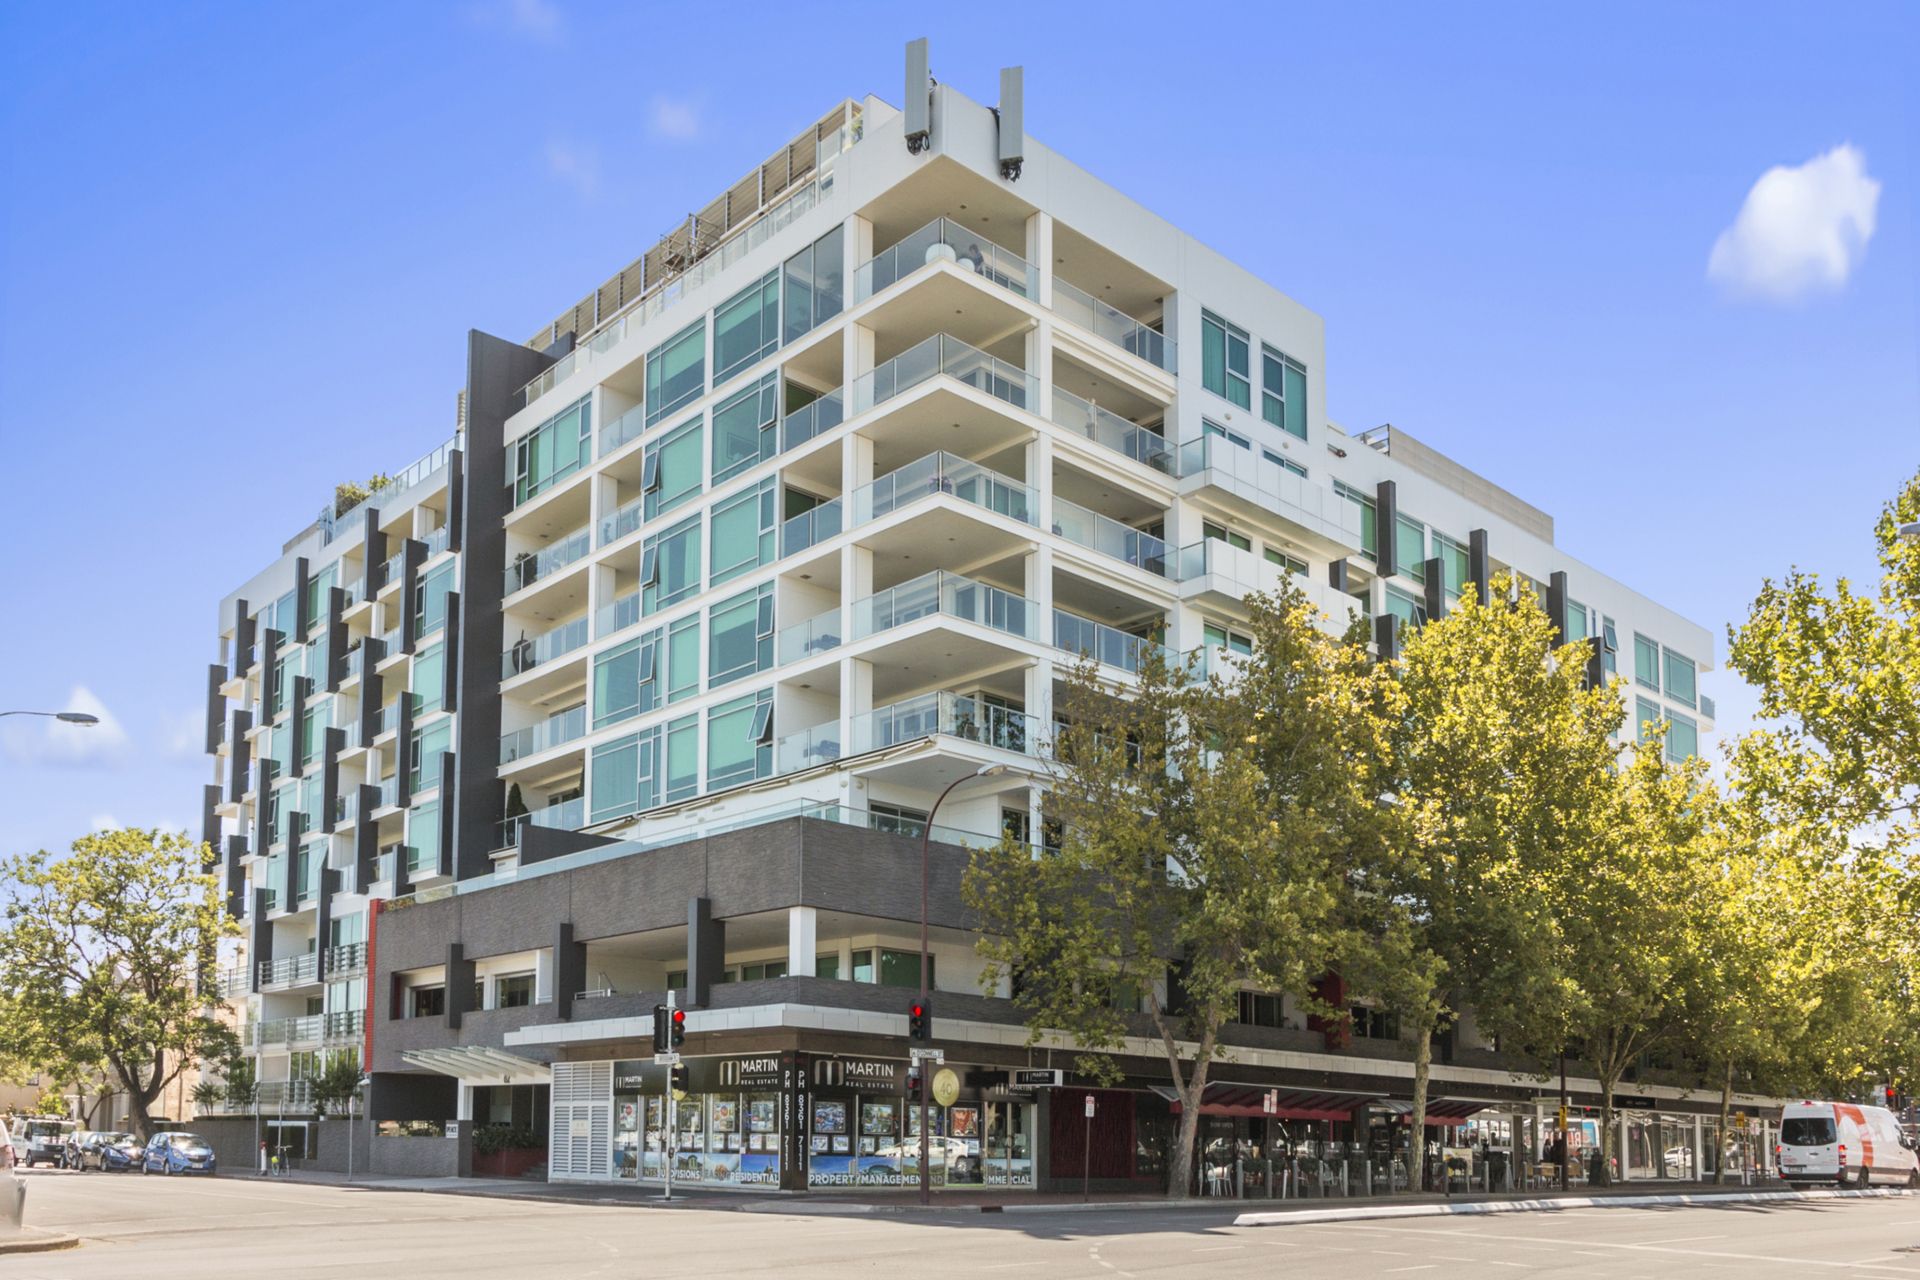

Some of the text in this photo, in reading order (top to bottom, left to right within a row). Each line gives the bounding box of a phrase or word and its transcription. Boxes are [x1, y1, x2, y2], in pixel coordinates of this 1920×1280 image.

[741, 1059, 779, 1073] MARTIN
[845, 1061, 894, 1077] MARTIN
[625, 1075, 643, 1083] MARTIN
[730, 1171, 779, 1184] RESIDENTIAL
[808, 1173, 860, 1185] PROPERTY
[861, 1174, 921, 1185] MANAGEMEN
